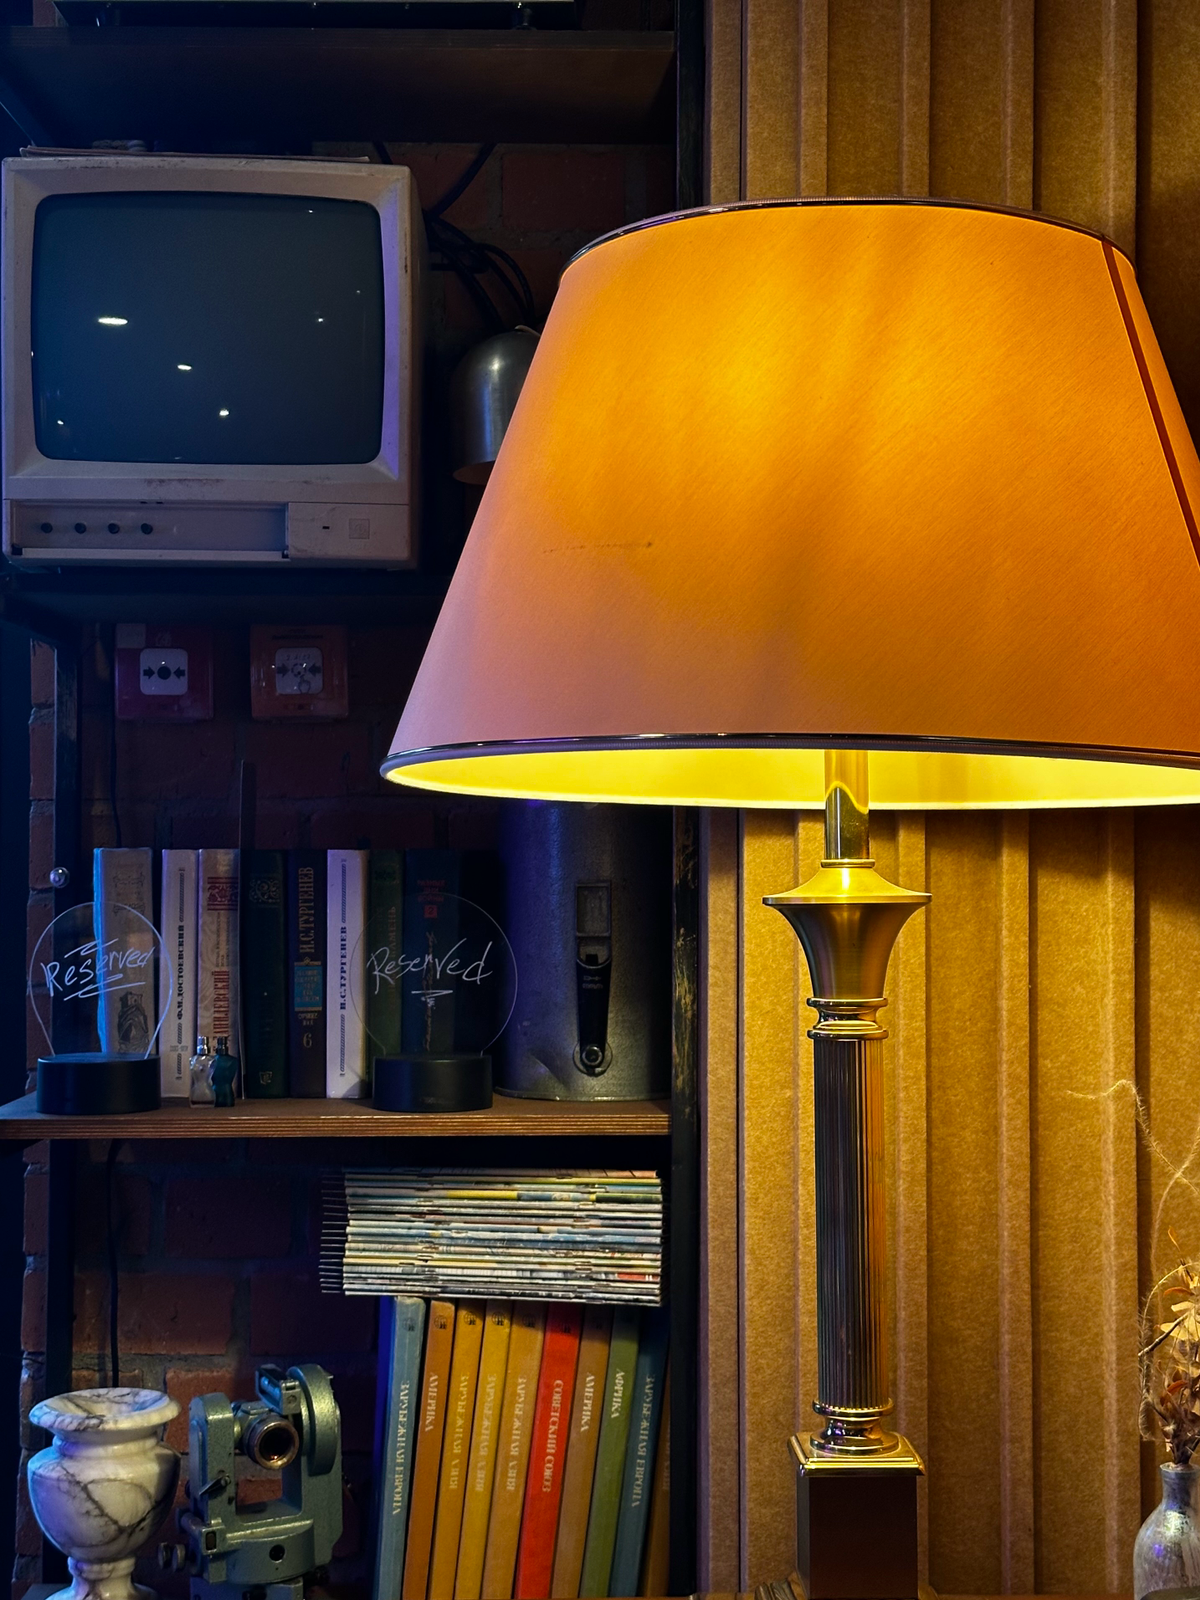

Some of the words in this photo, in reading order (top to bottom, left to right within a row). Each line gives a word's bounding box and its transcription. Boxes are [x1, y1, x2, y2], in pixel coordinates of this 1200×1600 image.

[40, 946, 155, 998] Reserved
[366, 937, 494, 996] Reserved
[302, 1032, 313, 1049] 6
[396, 1380, 410, 1463] ЗАРУБЕЖНАЯ
[424, 1371, 439, 1432] АМЕРИКА
[452, 1373, 470, 1453] ЗАРУБЕЖНАЯ
[478, 1373, 497, 1455] ЗАРУБЕЖНАЯ
[509, 1376, 527, 1456] ЗАРУБЕЖНАЯ
[545, 1379, 564, 1453] СОВЕТСКИЙ
[579, 1371, 595, 1432] АМЕРИКА
[610, 1368, 626, 1419] АФРИКА
[637, 1374, 656, 1456] ЗАРУБЕЖНАЯ
[392, 1466, 405, 1515] ЕВРОПА
[449, 1459, 460, 1489] АЗИЯ
[506, 1460, 518, 1491] АЗИЯ
[541, 1455, 555, 1493] СОЮЗ
[631, 1459, 645, 1508] ЕВРОПА
